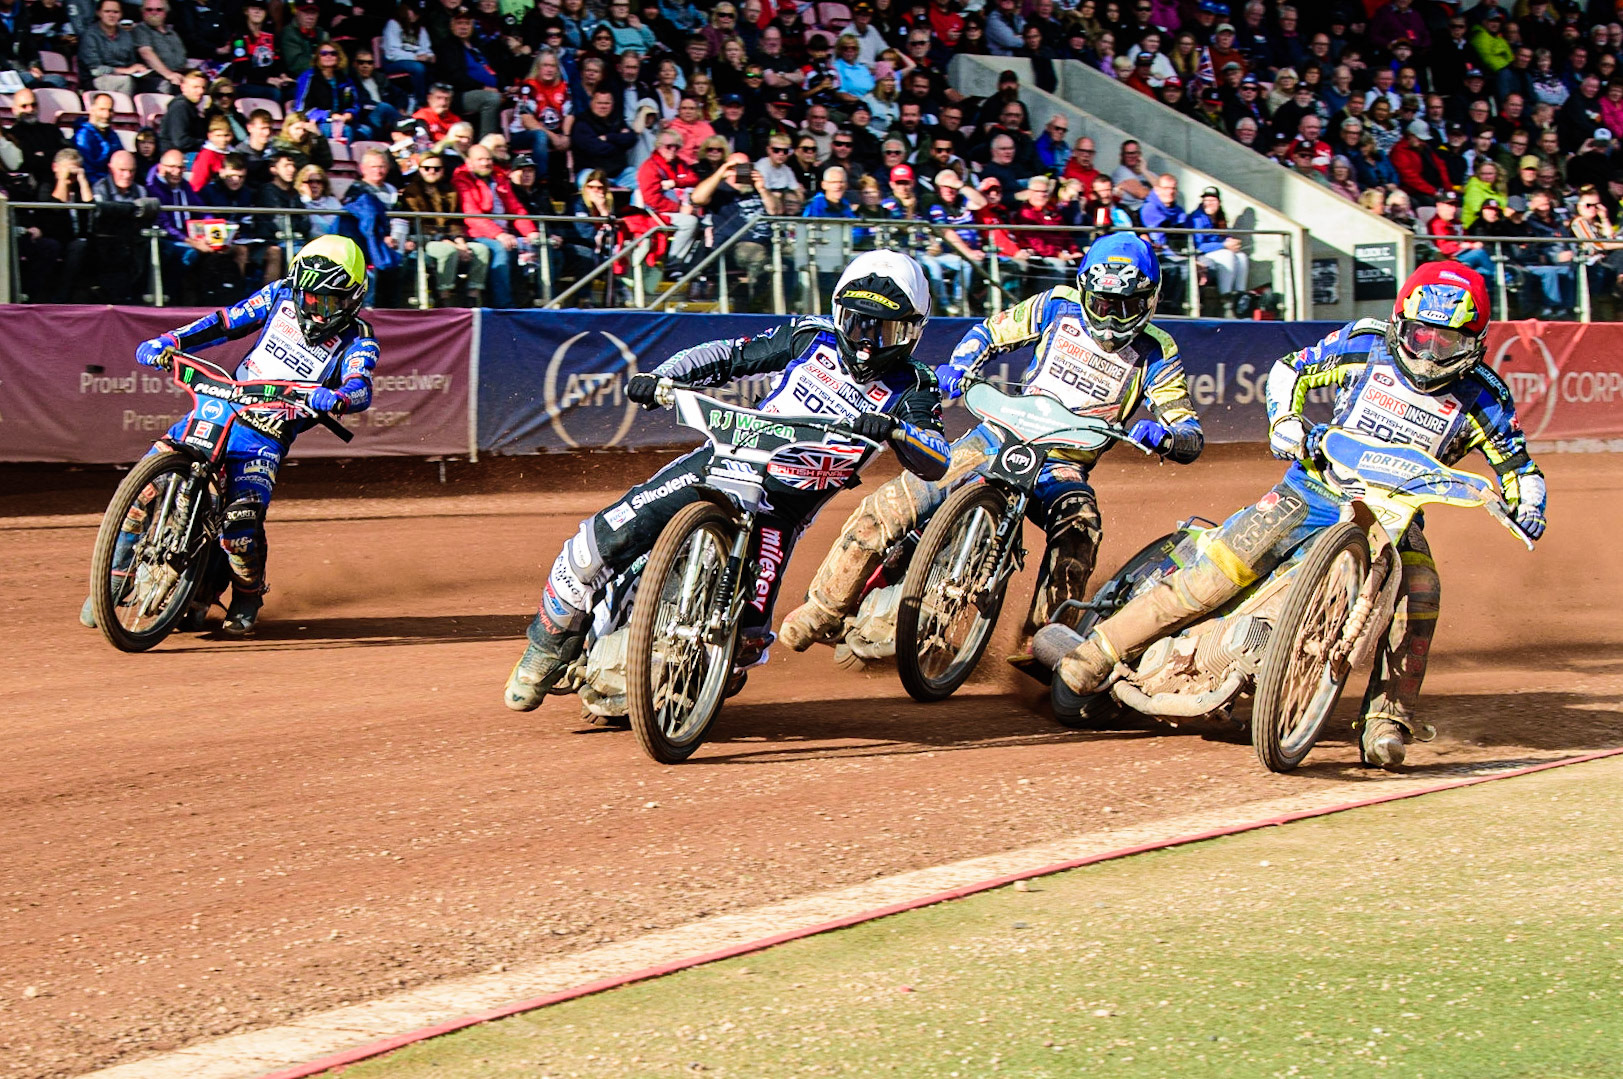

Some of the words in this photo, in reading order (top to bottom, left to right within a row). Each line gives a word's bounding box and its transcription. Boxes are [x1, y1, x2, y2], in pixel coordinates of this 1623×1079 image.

[264, 339, 313, 379] 2022
[1056, 338, 1091, 363] SPORTS
[1088, 353, 1125, 380] INSURE
[79, 371, 138, 394] Proud
[142, 375, 162, 393] to
[372, 368, 453, 397] peedway
[560, 372, 623, 407] ATPI
[799, 374, 835, 405] BRITISH
[834, 403, 857, 422] FINA
[806, 365, 842, 391] SPORTS
[839, 384, 877, 414] INSURE
[1049, 362, 1110, 402] 2022
[1562, 370, 1623, 404] CORP
[735, 412, 796, 441] Warren
[1363, 407, 1404, 431] BRITISH
[1404, 427, 1433, 445] FINAL
[1366, 388, 1407, 416] SPORTS
[1404, 405, 1448, 434] INSURE
[770, 464, 815, 477] BRITISH
[816, 468, 846, 477] FINAL
[1006, 451, 1031, 467] ATPI
[750, 527, 784, 614] milesey
